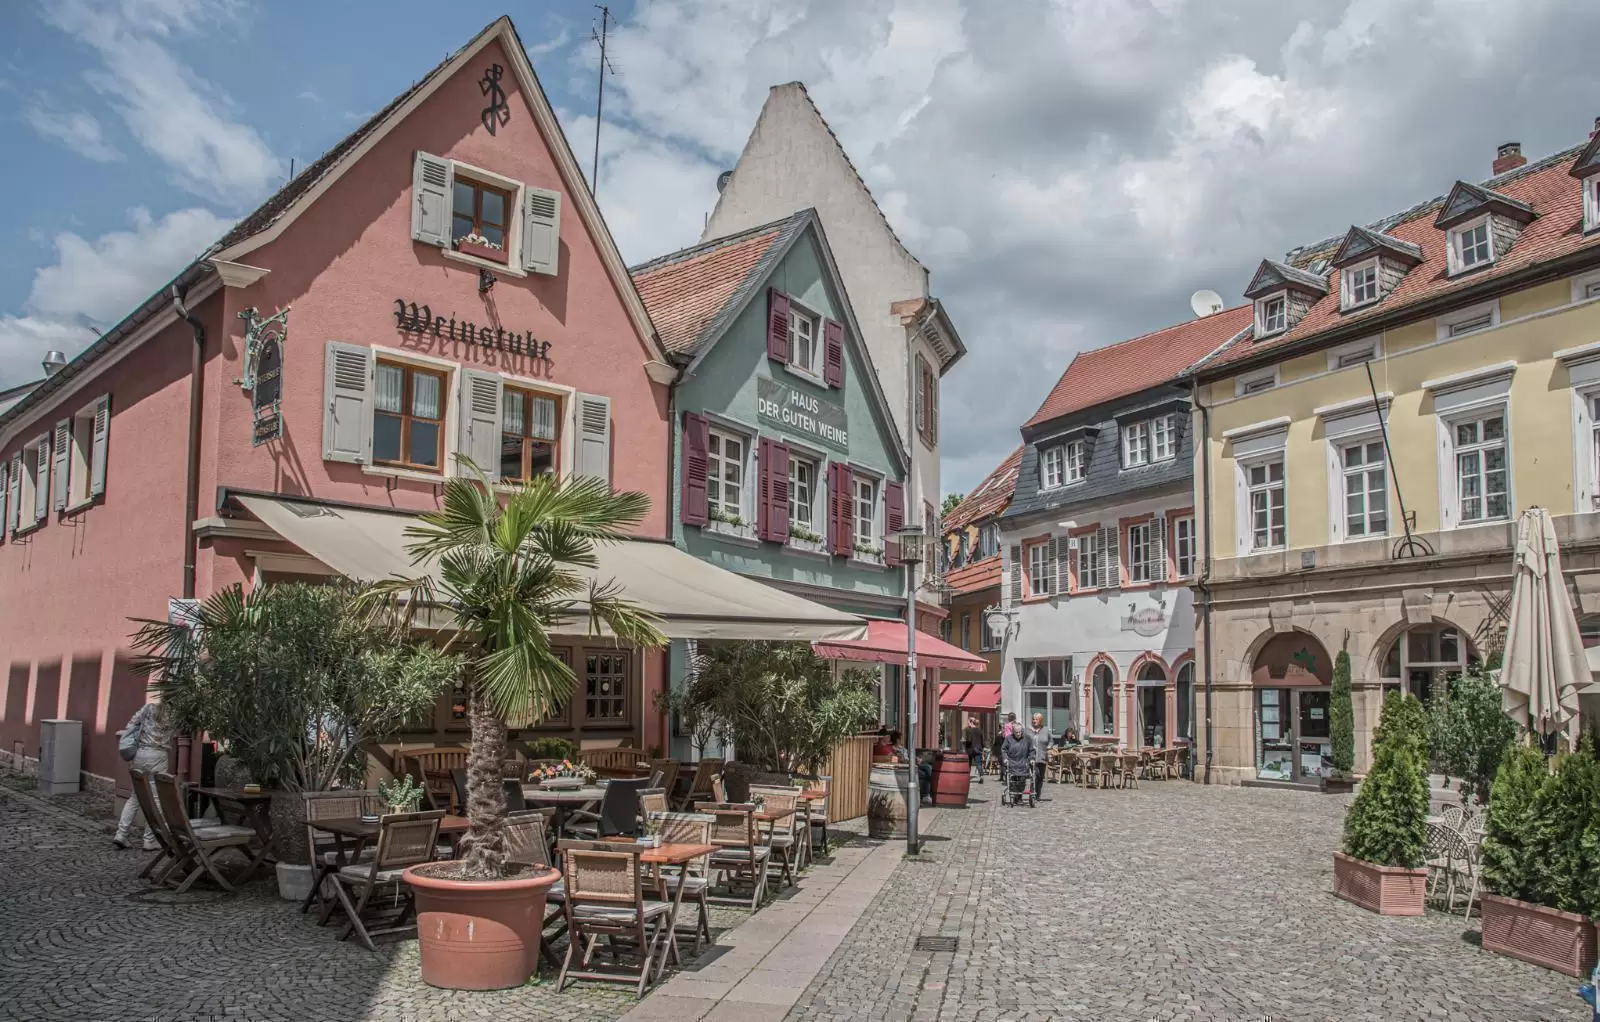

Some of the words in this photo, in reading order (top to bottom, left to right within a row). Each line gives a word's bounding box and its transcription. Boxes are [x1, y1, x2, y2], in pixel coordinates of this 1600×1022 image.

[393, 298, 553, 361] Weinstube
[758, 398, 780, 420] DER
[782, 407, 816, 434] GUTEN
[818, 421, 848, 446] WEINE
[790, 390, 819, 414] HAUS
